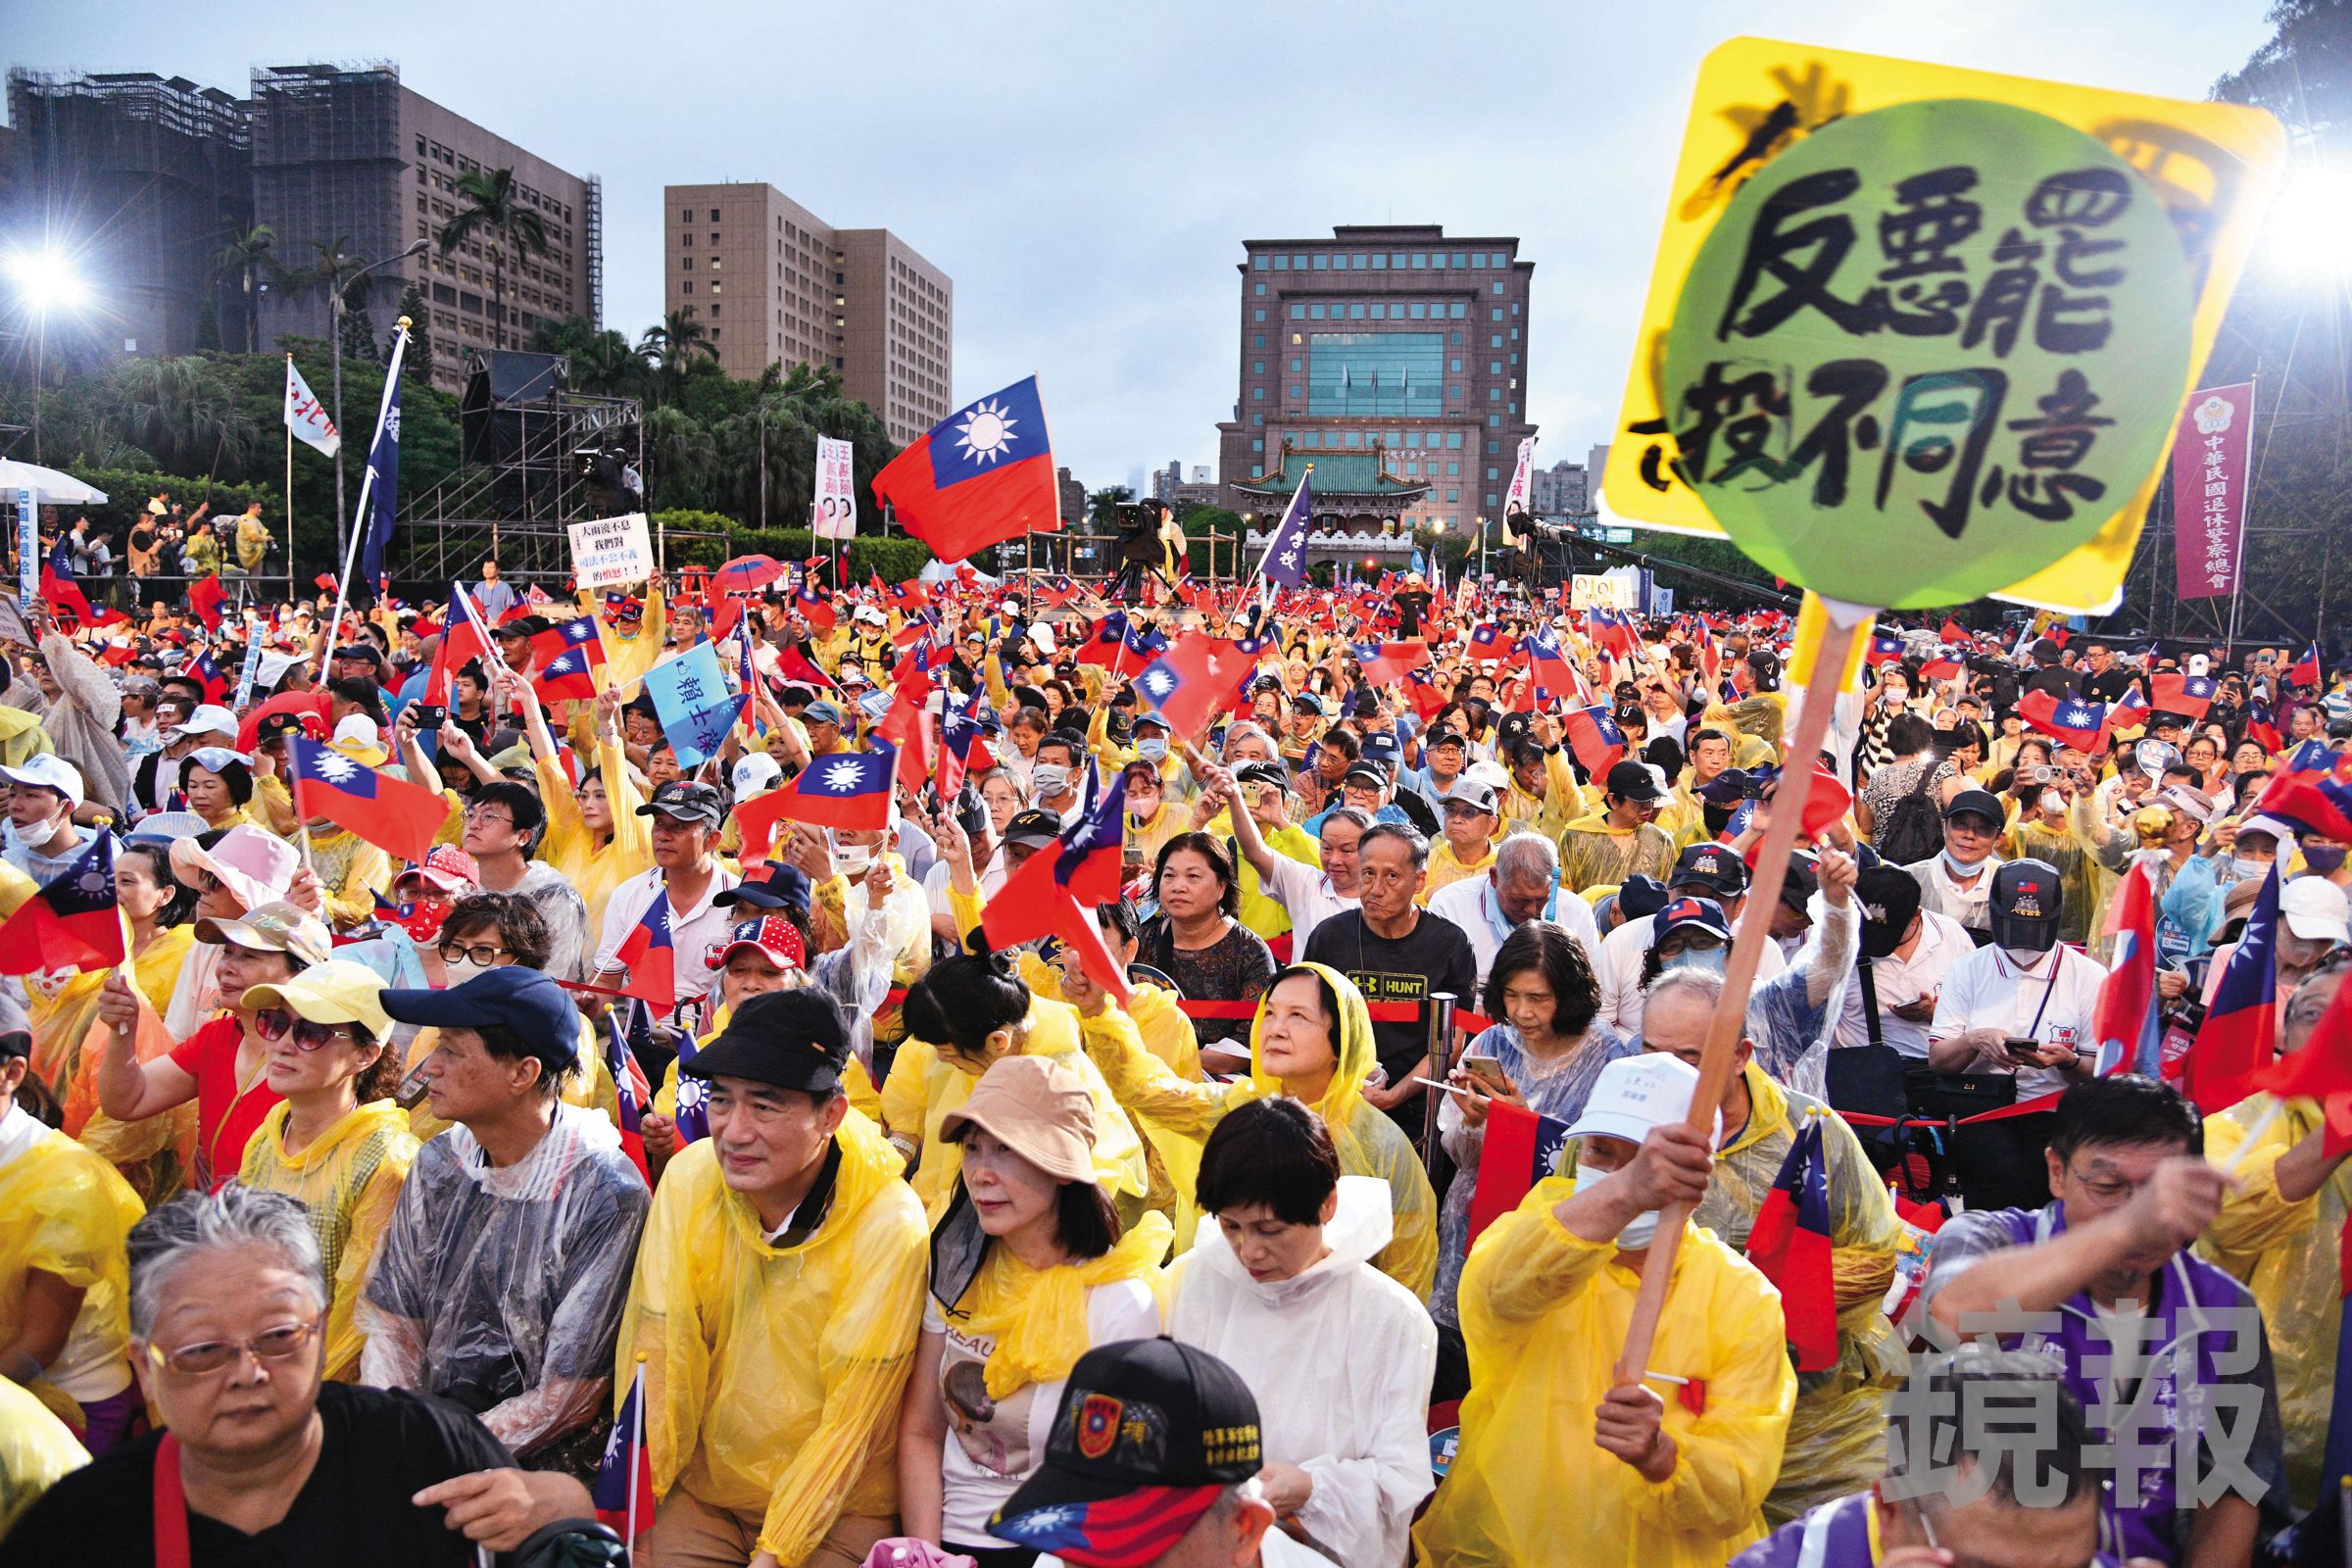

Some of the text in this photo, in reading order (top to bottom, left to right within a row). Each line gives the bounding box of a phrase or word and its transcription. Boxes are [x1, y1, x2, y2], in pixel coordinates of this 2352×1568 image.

[1717, 164, 2132, 358] 反惡罷
[1677, 357, 2116, 540] 投不同意
[595, 536, 624, 551] 我們對
[2203, 435, 2231, 588] 中華民國退休警察總會
[579, 548, 639, 567] 司法不公不義
[1386, 981, 1422, 994] HUNT
